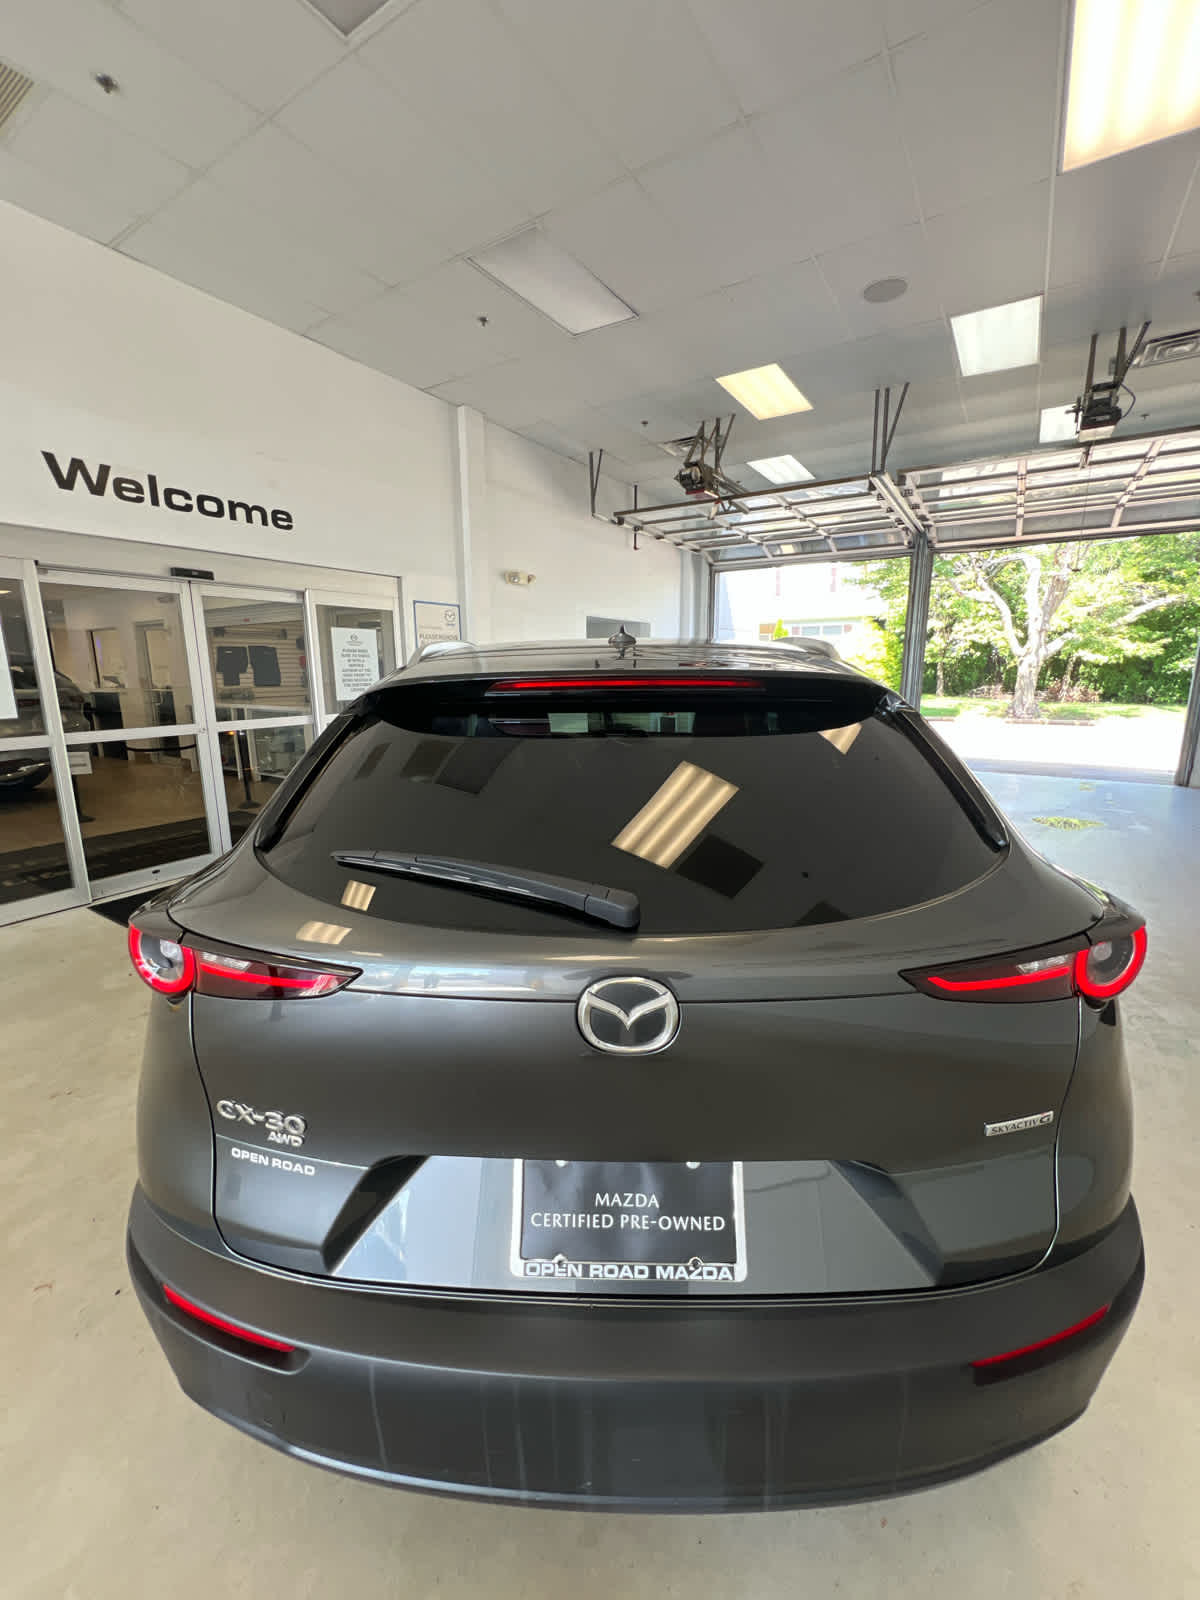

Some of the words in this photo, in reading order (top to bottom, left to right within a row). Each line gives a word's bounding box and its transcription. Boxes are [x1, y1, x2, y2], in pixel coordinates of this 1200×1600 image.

[40, 449, 294, 531] Welcome
[216, 1099, 307, 1136] CX-30
[991, 1118, 1039, 1135] SKYACTIV
[267, 1131, 304, 1148] AWD
[231, 1147, 269, 1167] OPEN
[271, 1157, 316, 1177] ROAD
[594, 1192, 660, 1209] MAZDA
[530, 1212, 615, 1230] CERTIFIED
[620, 1214, 726, 1232] PRE-OWNED
[525, 1261, 583, 1279] OPEN
[589, 1263, 649, 1280] ROAD
[655, 1265, 735, 1281] MAZDA
